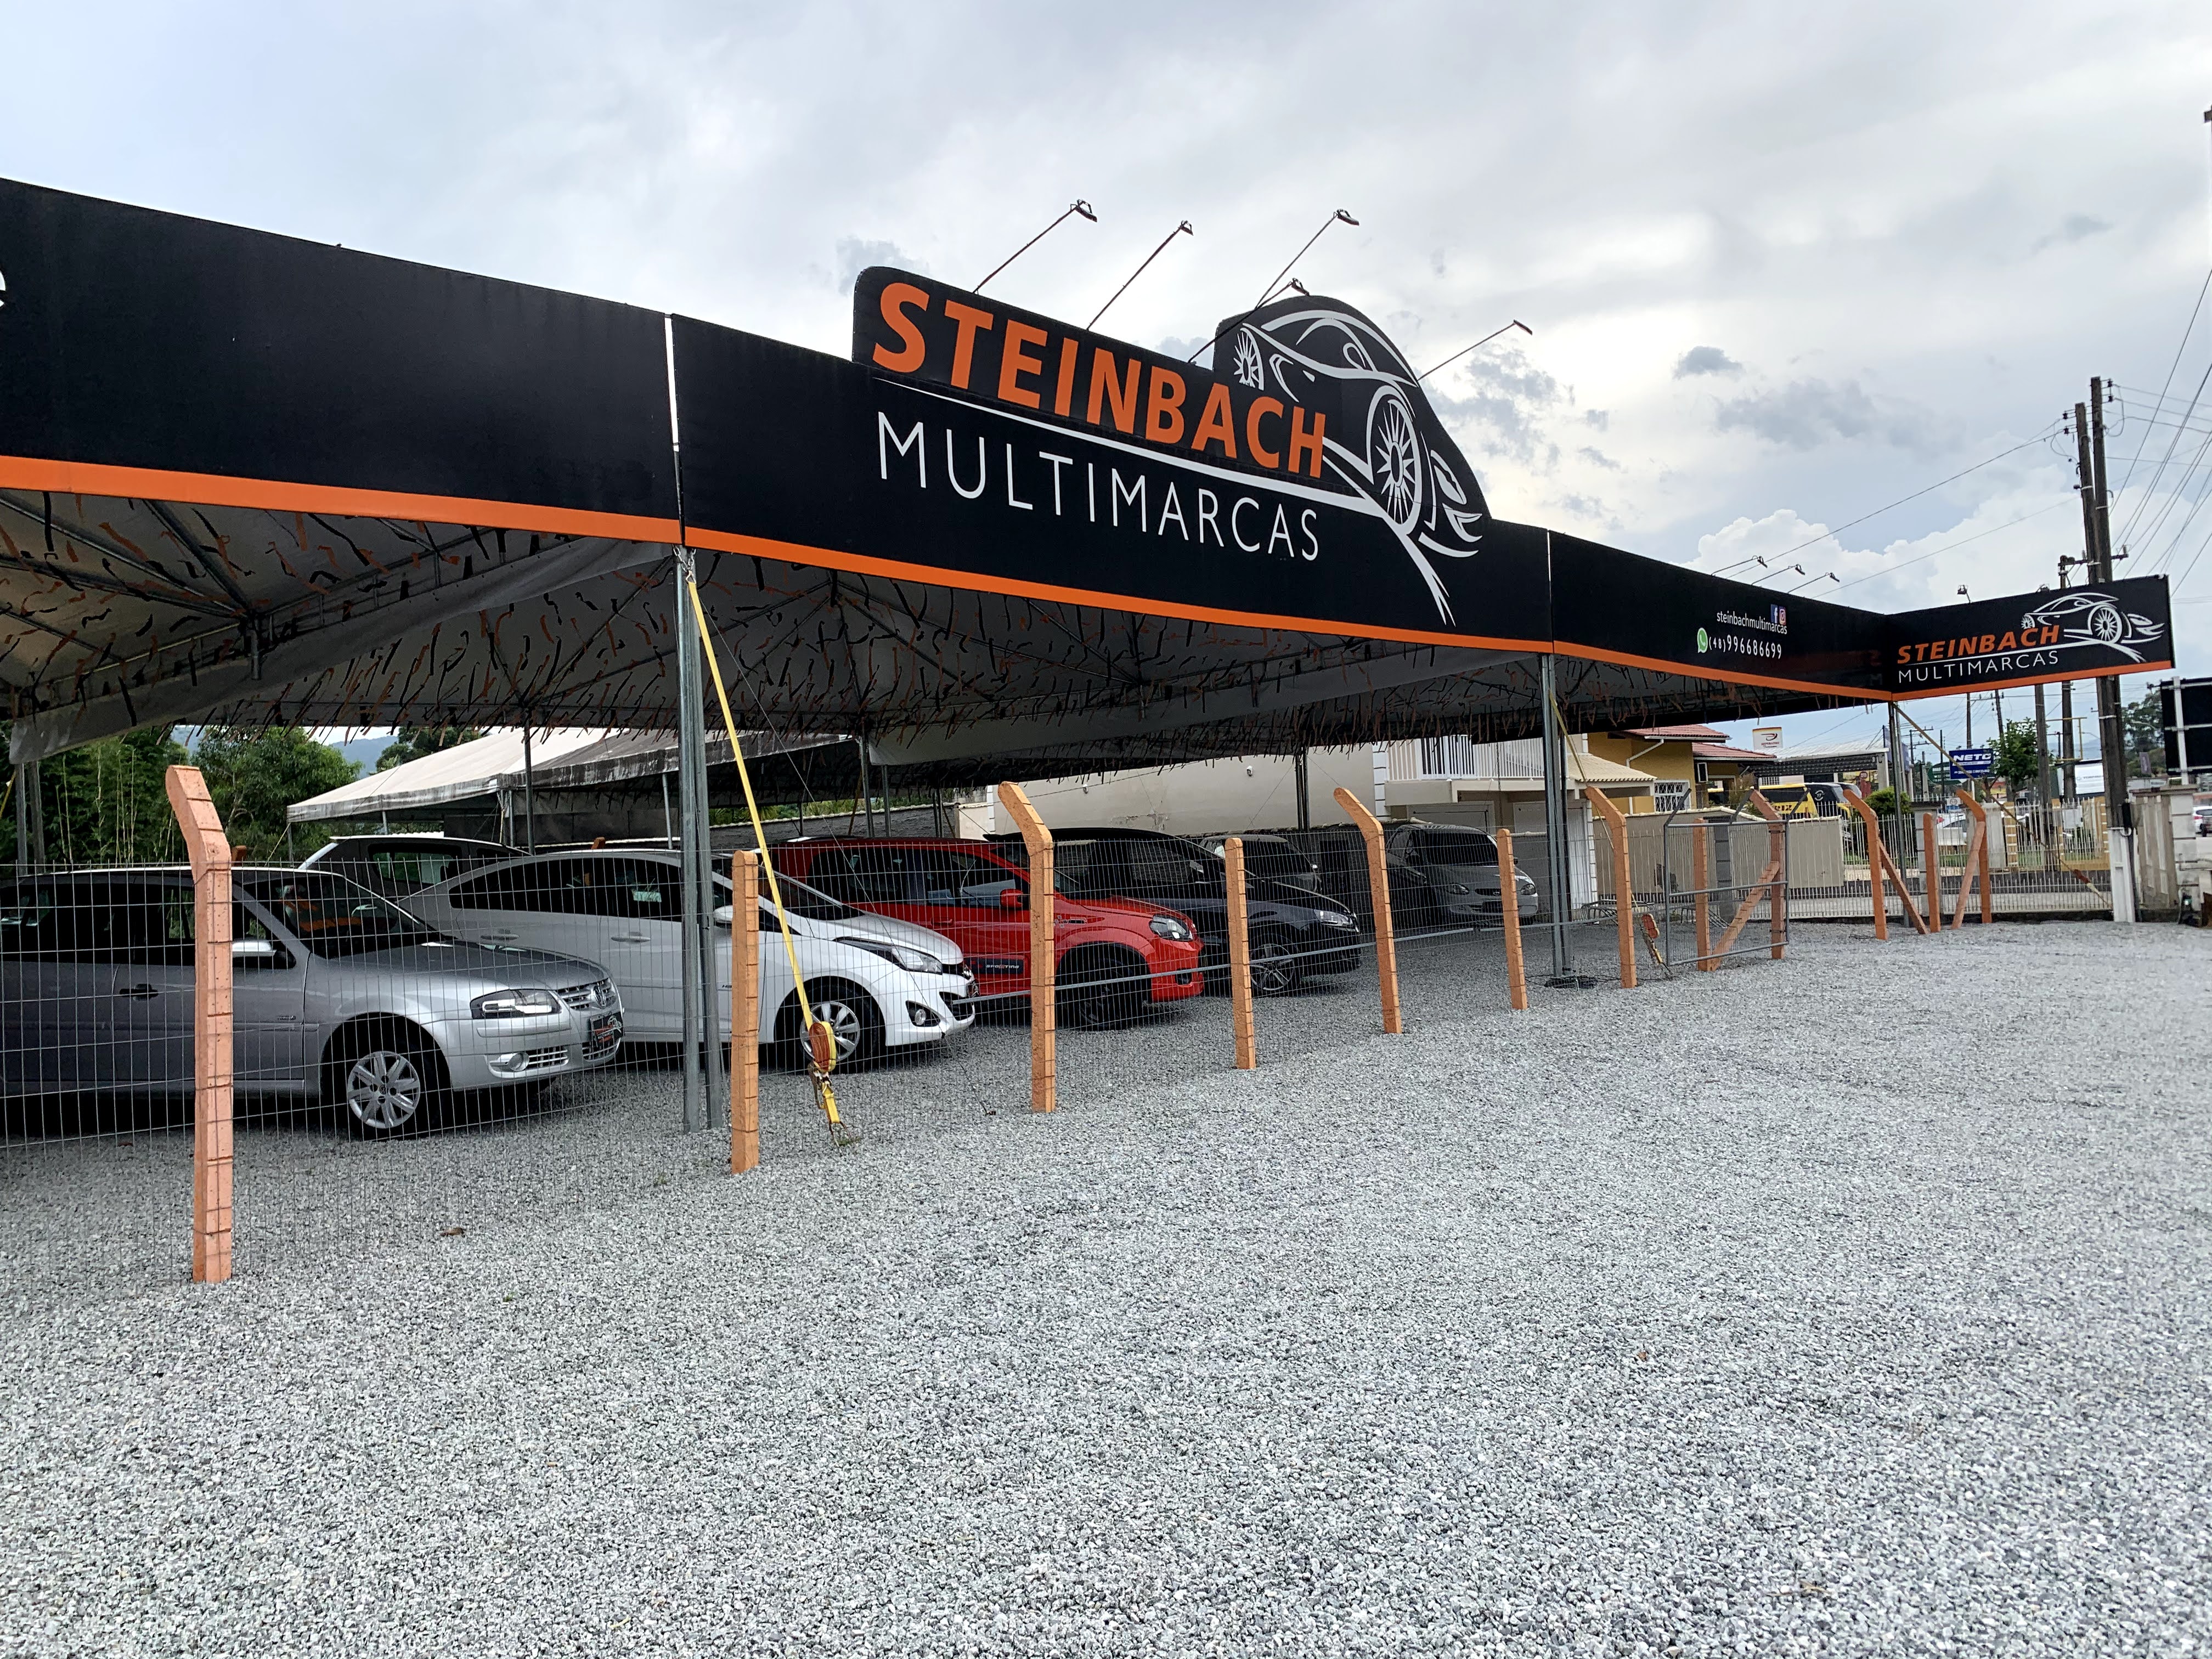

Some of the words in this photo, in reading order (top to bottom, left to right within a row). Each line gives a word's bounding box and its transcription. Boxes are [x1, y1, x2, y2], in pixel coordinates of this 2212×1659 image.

[872, 282, 1326, 478] STEINBACH
[878, 411, 1318, 561] MULTIMARCAS
[1717, 611, 1787, 634] steinbachmultimarcas
[1897, 625, 2060, 664] STEINBACH
[1898, 651, 2058, 684] MULTIMARCAS
